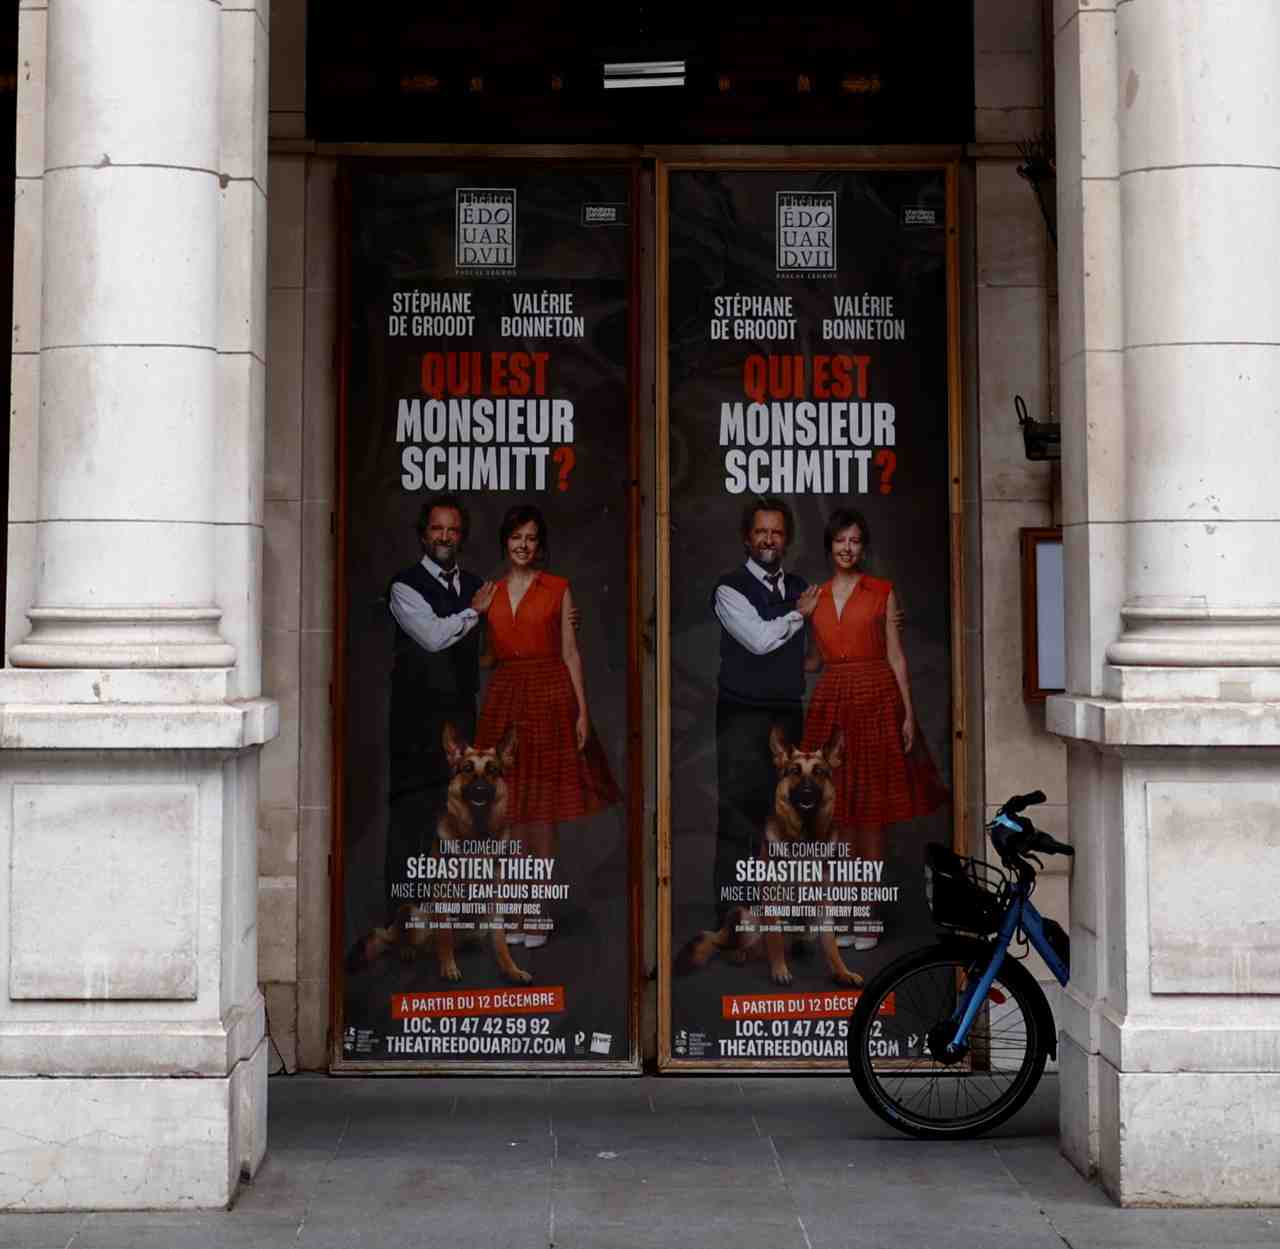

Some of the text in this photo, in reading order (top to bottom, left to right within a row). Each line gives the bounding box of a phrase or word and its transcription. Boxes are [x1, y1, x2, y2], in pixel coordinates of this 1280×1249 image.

[461, 192, 513, 204] Théâtre
[782, 194, 833, 207] Théâtre
[462, 204, 511, 225] ÉDO
[783, 206, 831, 228] ÉDO
[462, 227, 511, 245] UAR
[783, 230, 831, 248] UAR
[783, 250, 829, 268] D.VII
[392, 289, 472, 314] STÉPHANE
[512, 289, 573, 315] VALÉRIE
[713, 292, 793, 318] STÉPHANE
[833, 292, 894, 318] VALÉRIE
[388, 315, 476, 337] DE GROODT
[500, 316, 585, 338] BONNETON
[710, 319, 798, 340] DE GROODT
[822, 319, 905, 340] BONNETON
[421, 351, 551, 401] QUI EST
[743, 353, 871, 406] QUI EST
[395, 398, 575, 444] MONSIEUR
[719, 401, 896, 447] MONSIEUR
[440, 837, 522, 855] UNE COMÉDIE DE
[769, 840, 852, 858] UNE COMÉDIE DE
[406, 854, 555, 880] SÉBASTIEN THIÉRY
[735, 857, 884, 883] SÉBASTIEN THIÉRY
[391, 881, 570, 900] MISE EN SCÈNE JEAN-LOUIS BENOIT
[720, 884, 899, 903] MISE EN SCÈNE JEAN-LOUIS BENOIT
[400, 991, 555, 1012] À PARTIR DU 12 DÉCEMBRE
[731, 1000, 740, 1014] À
[742, 999, 785, 1013] PARTIR
[788, 998, 805, 1012] DU
[808, 997, 821, 1011] 12
[403, 1017, 550, 1035] LOC. 01 47 42 59 92
[735, 1020, 768, 1037] LOC.
[771, 1020, 790, 1037] 01
[791, 1020, 812, 1037] 47
[814, 1020, 835, 1037] 42
[869, 1020, 882, 1037] 2
[386, 1036, 566, 1055] THEATREEDOUARD7.COM
